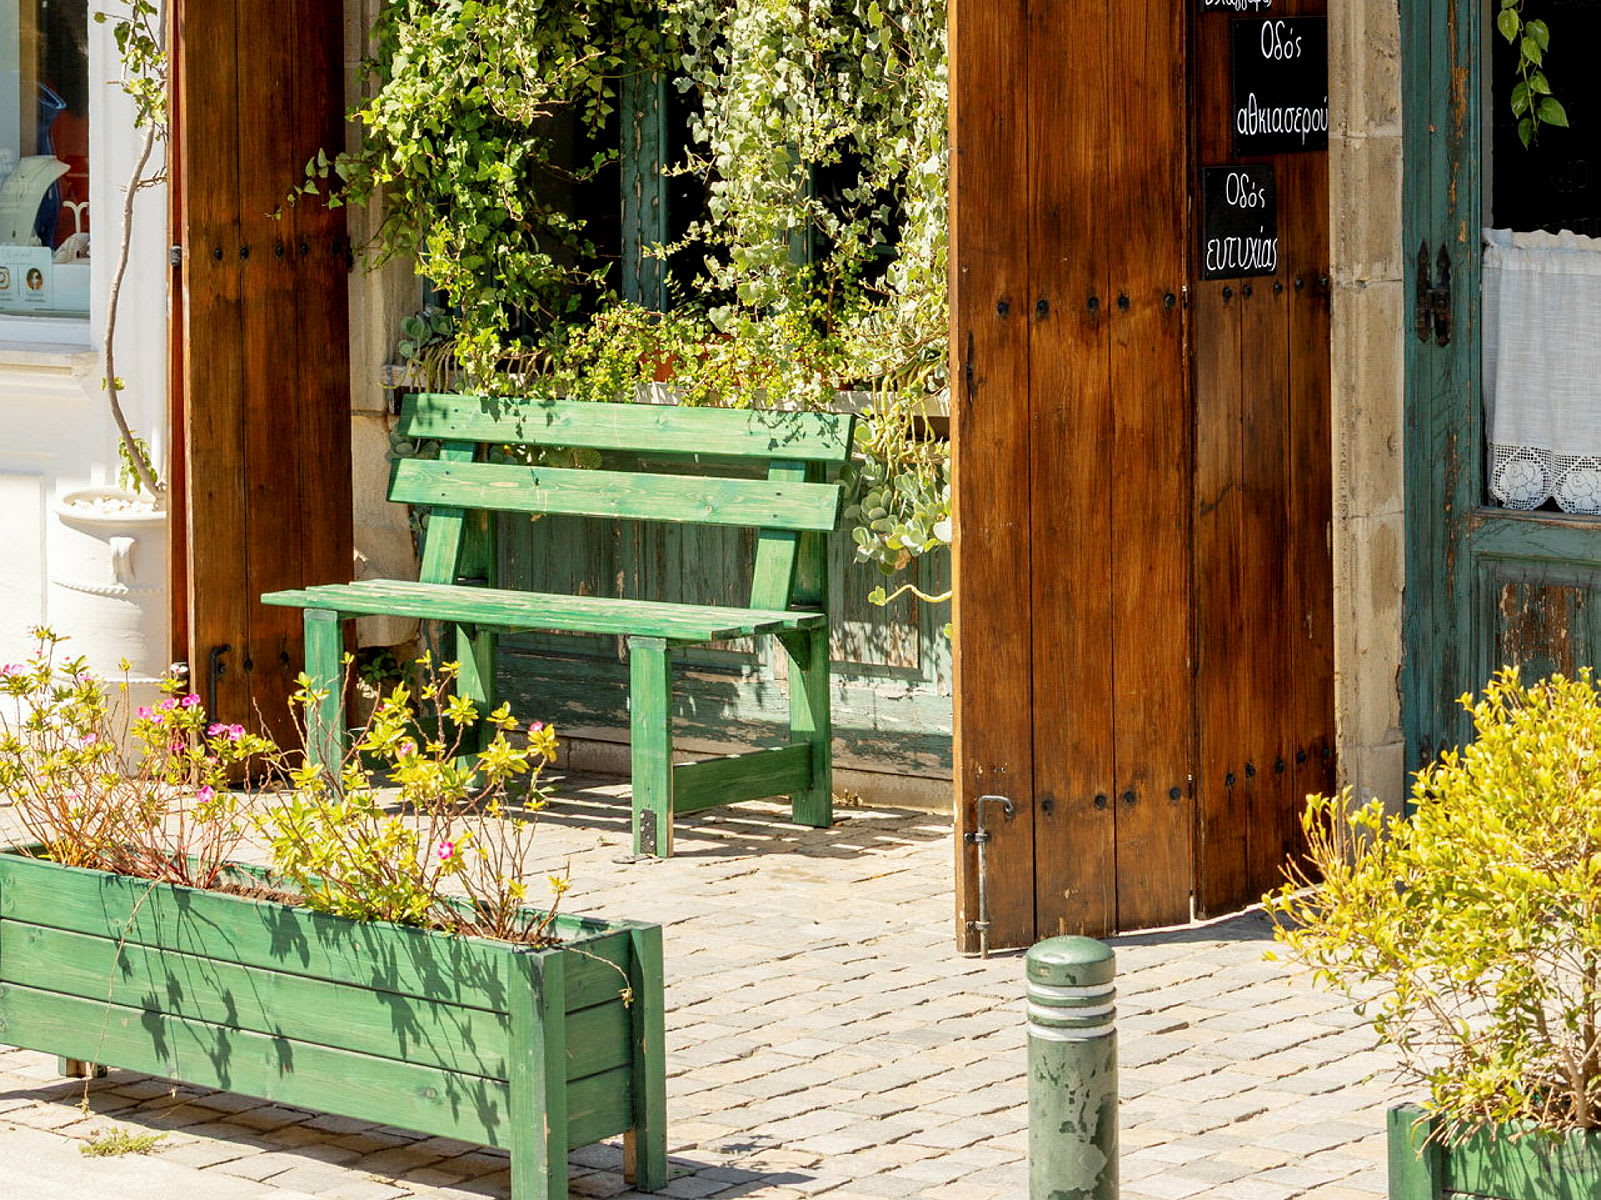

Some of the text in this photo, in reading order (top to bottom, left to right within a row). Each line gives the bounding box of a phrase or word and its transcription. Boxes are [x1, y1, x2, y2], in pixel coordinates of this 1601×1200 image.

[1260, 20, 1302, 60] Οδός
[1237, 92, 1328, 145] αθκιασερού
[1226, 172, 1266, 208] Οδός
[1206, 225, 1279, 272] ευτυχίας
